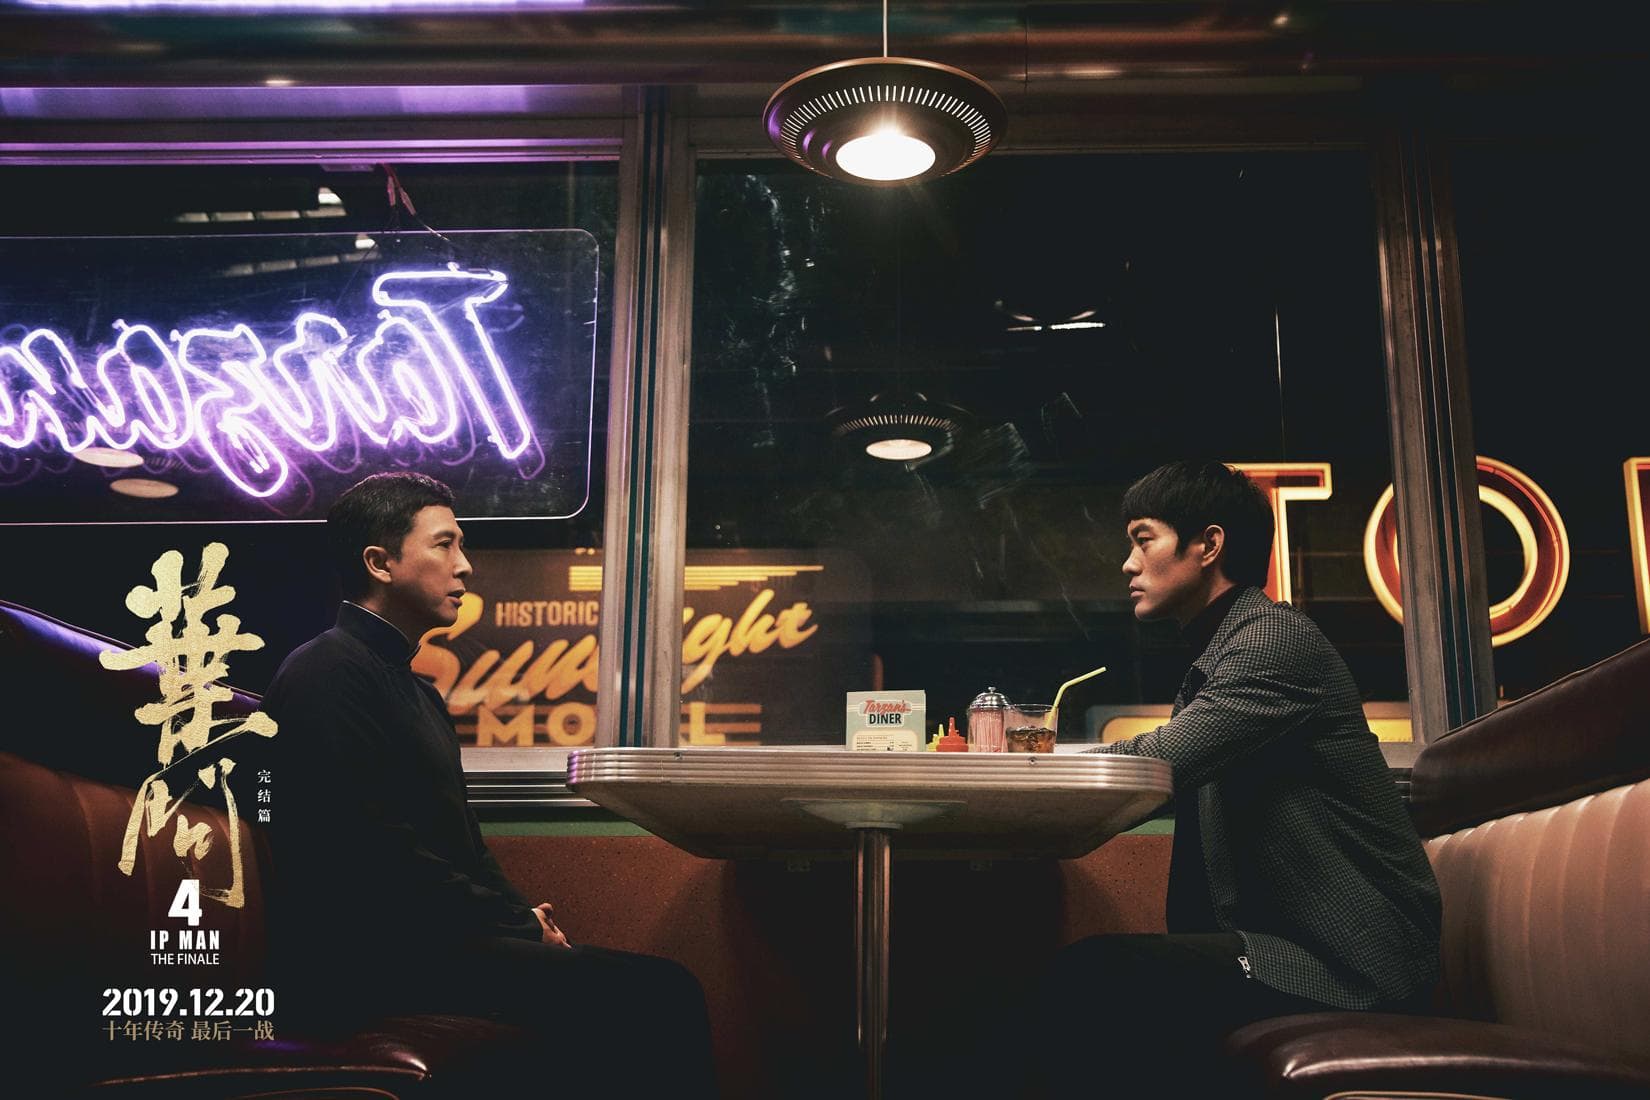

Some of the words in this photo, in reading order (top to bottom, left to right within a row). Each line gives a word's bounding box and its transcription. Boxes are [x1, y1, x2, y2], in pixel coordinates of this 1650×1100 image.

[494, 600, 599, 628] HISTORIC
[411, 588, 819, 716] Sunght
[476, 702, 727, 747] MOL
[869, 713, 902, 725] DINER
